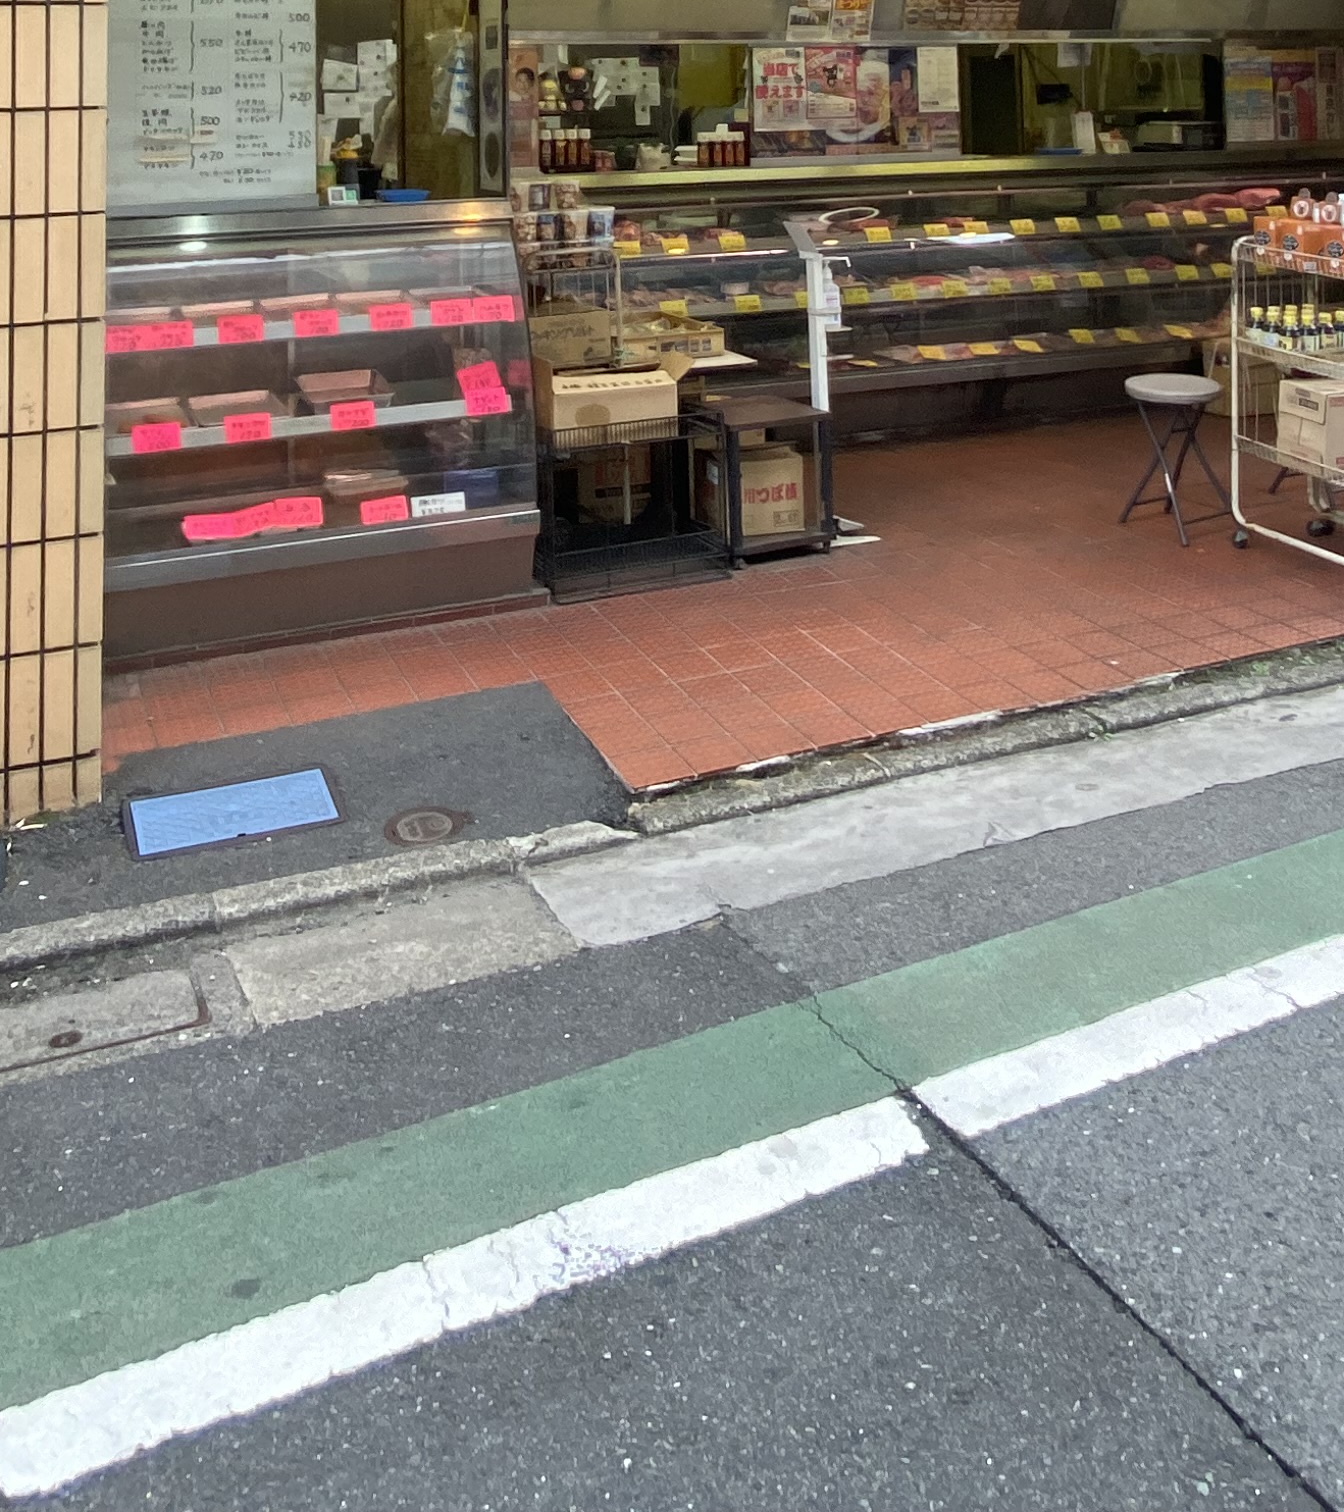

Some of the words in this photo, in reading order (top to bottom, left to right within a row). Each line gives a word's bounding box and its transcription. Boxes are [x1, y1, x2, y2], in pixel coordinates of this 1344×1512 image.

[288, 12, 310, 22] 500
[288, 41, 312, 53] 470
[200, 116, 221, 126] 500
[199, 151, 224, 162] 470
